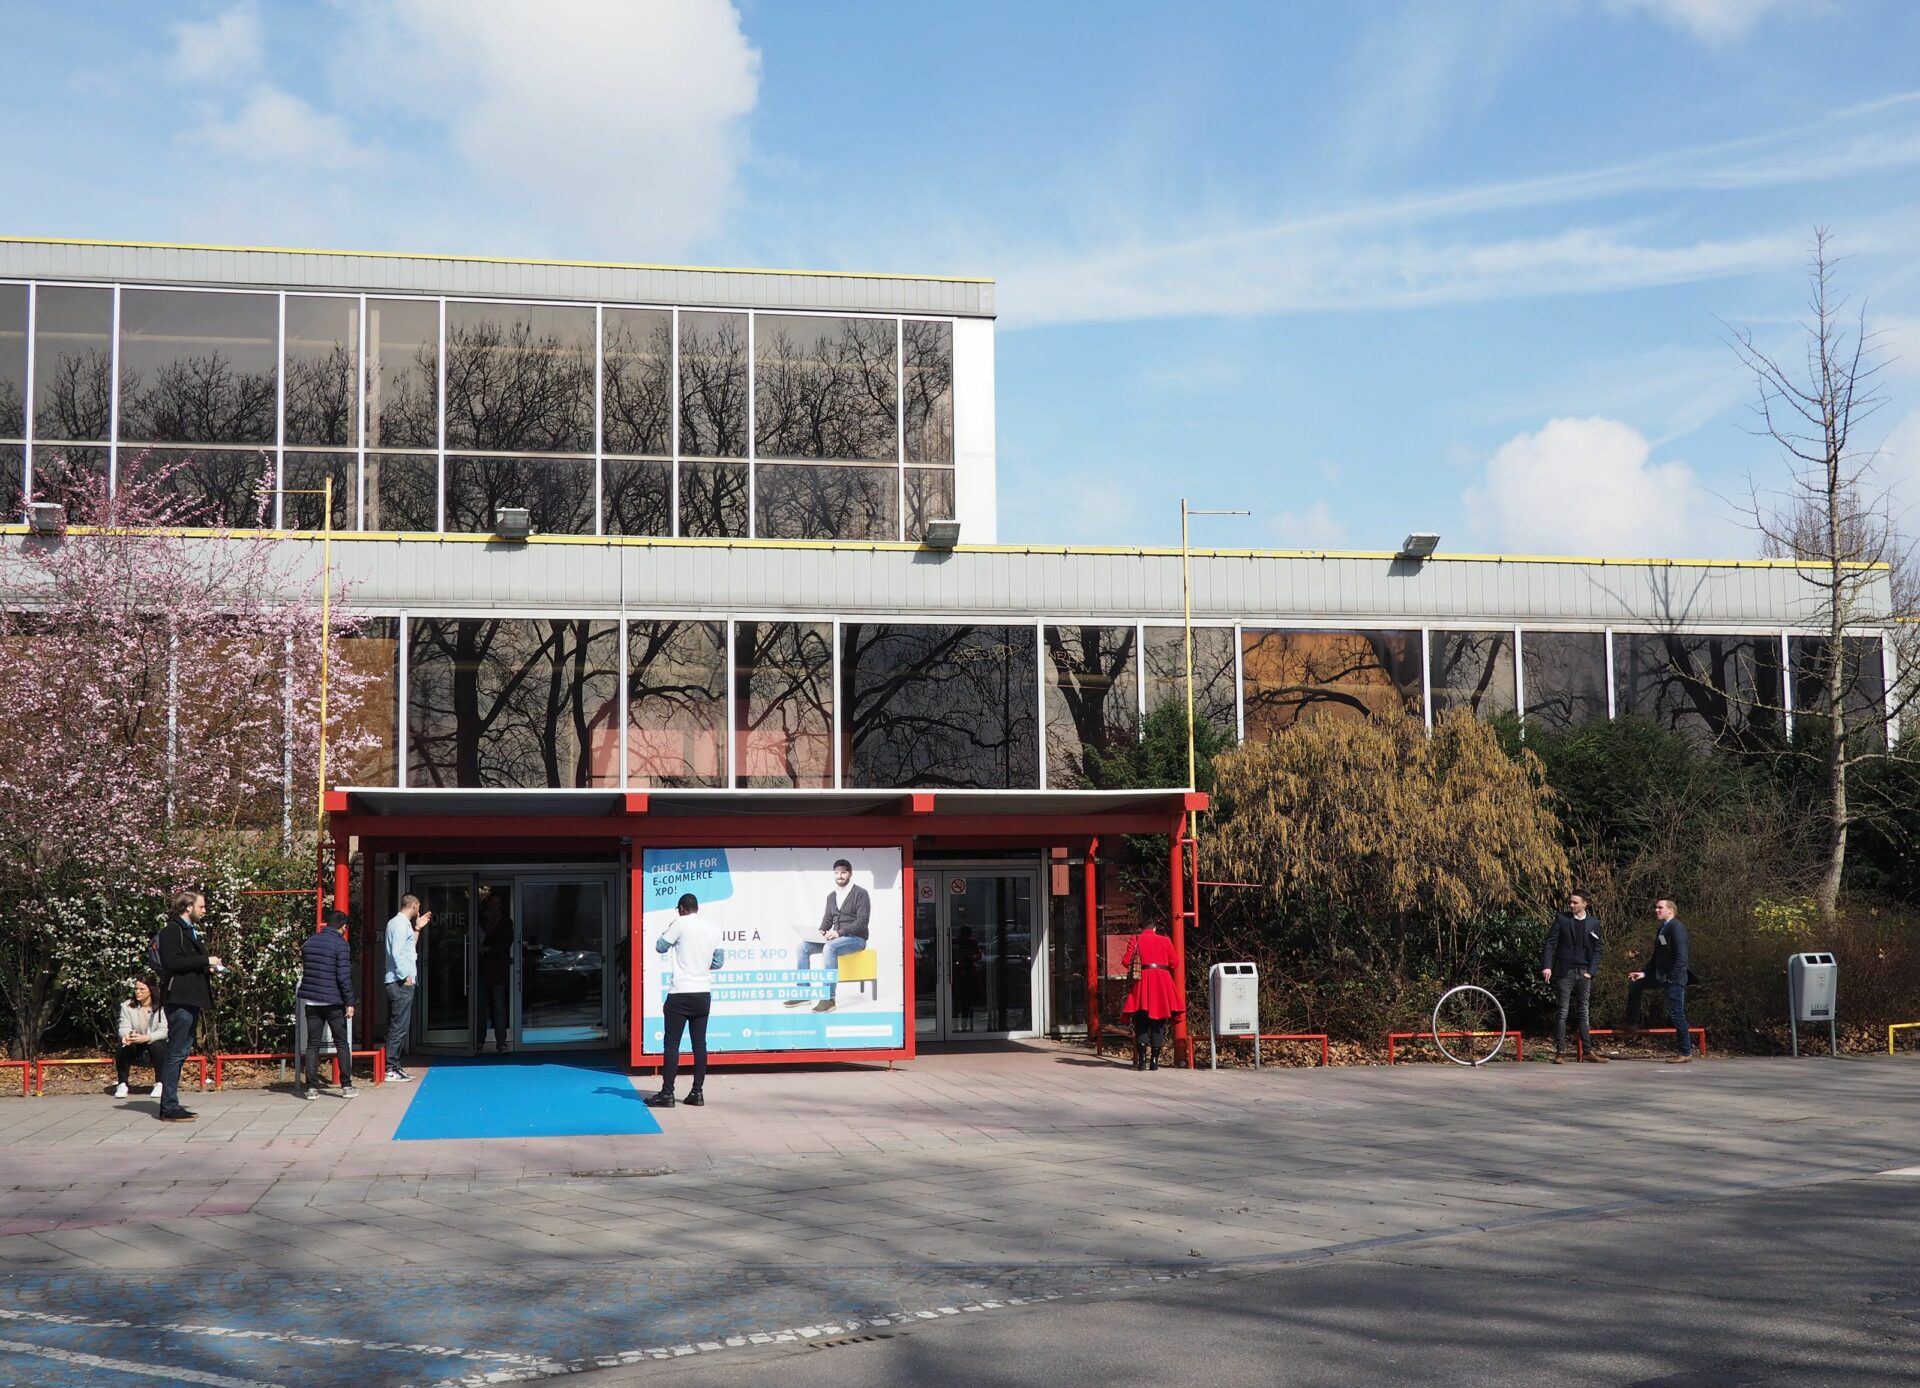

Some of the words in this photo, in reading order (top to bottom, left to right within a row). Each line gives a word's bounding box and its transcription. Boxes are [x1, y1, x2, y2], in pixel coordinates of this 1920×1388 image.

[651, 860, 697, 874] CHECK-IN
[699, 857, 718, 869] FOR
[653, 870, 713, 886] E-COMMERCE
[655, 885, 677, 897] XPO!
[432, 911, 466, 926] ORTIE
[760, 948, 788, 960] XPO
[756, 972, 777, 982] QUI
[782, 971, 833, 981] STIMULE
[712, 989, 774, 1000] BUSINESS
[778, 988, 826, 998] DIGITAL
